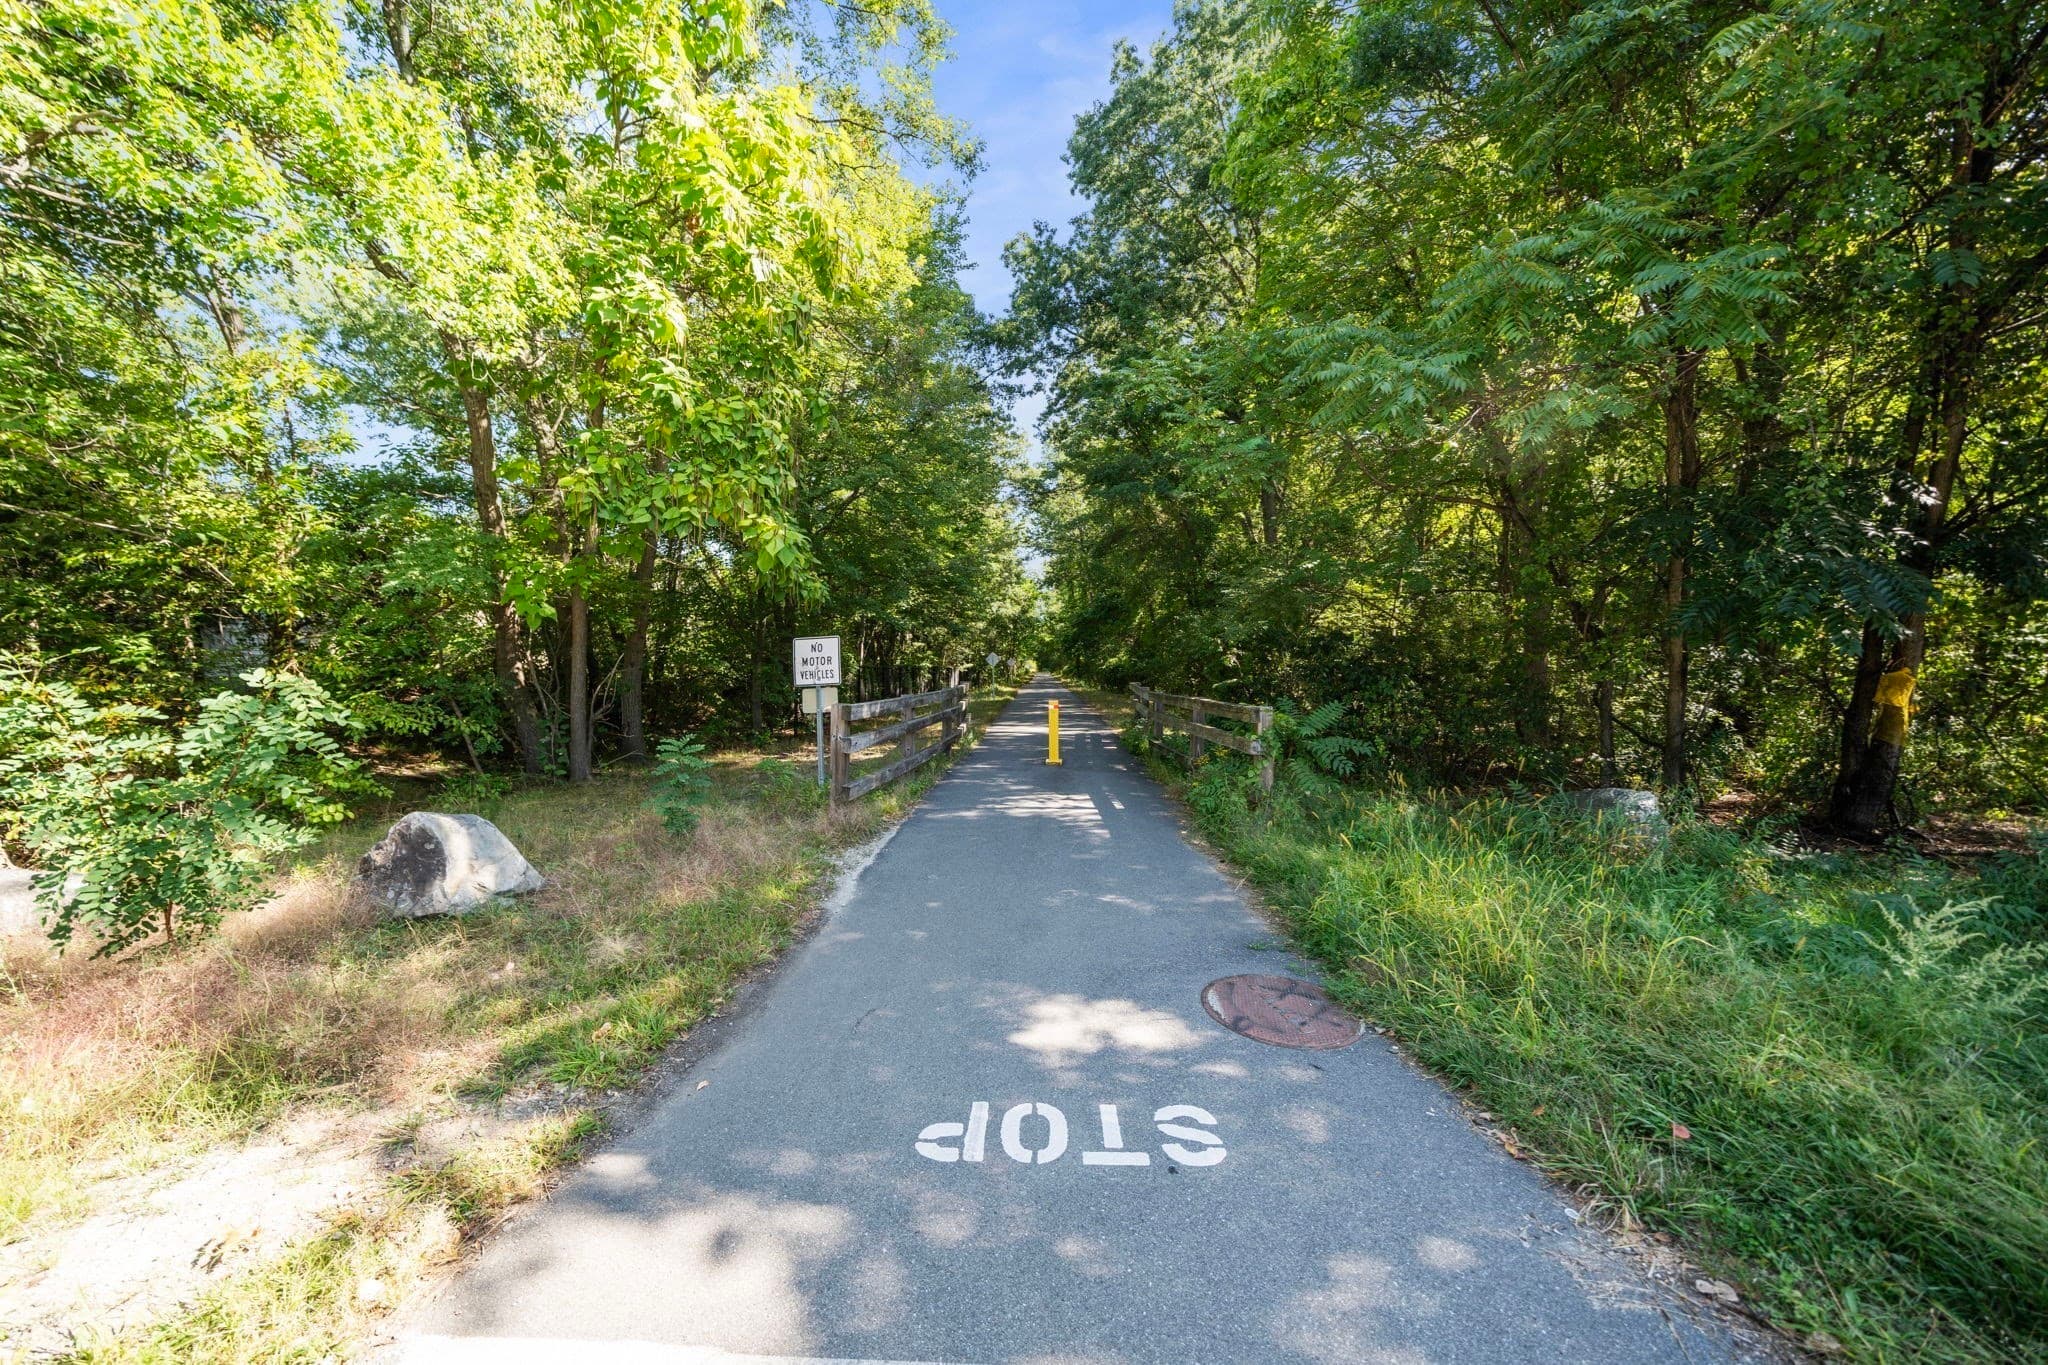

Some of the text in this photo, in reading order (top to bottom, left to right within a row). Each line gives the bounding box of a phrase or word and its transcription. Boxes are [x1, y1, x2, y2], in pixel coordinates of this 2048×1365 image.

[810, 643, 823, 653] NO
[802, 656, 832, 667] MOTOR
[800, 669, 834, 680] VEHICLES
[914, 1101, 1227, 1167] STOP
